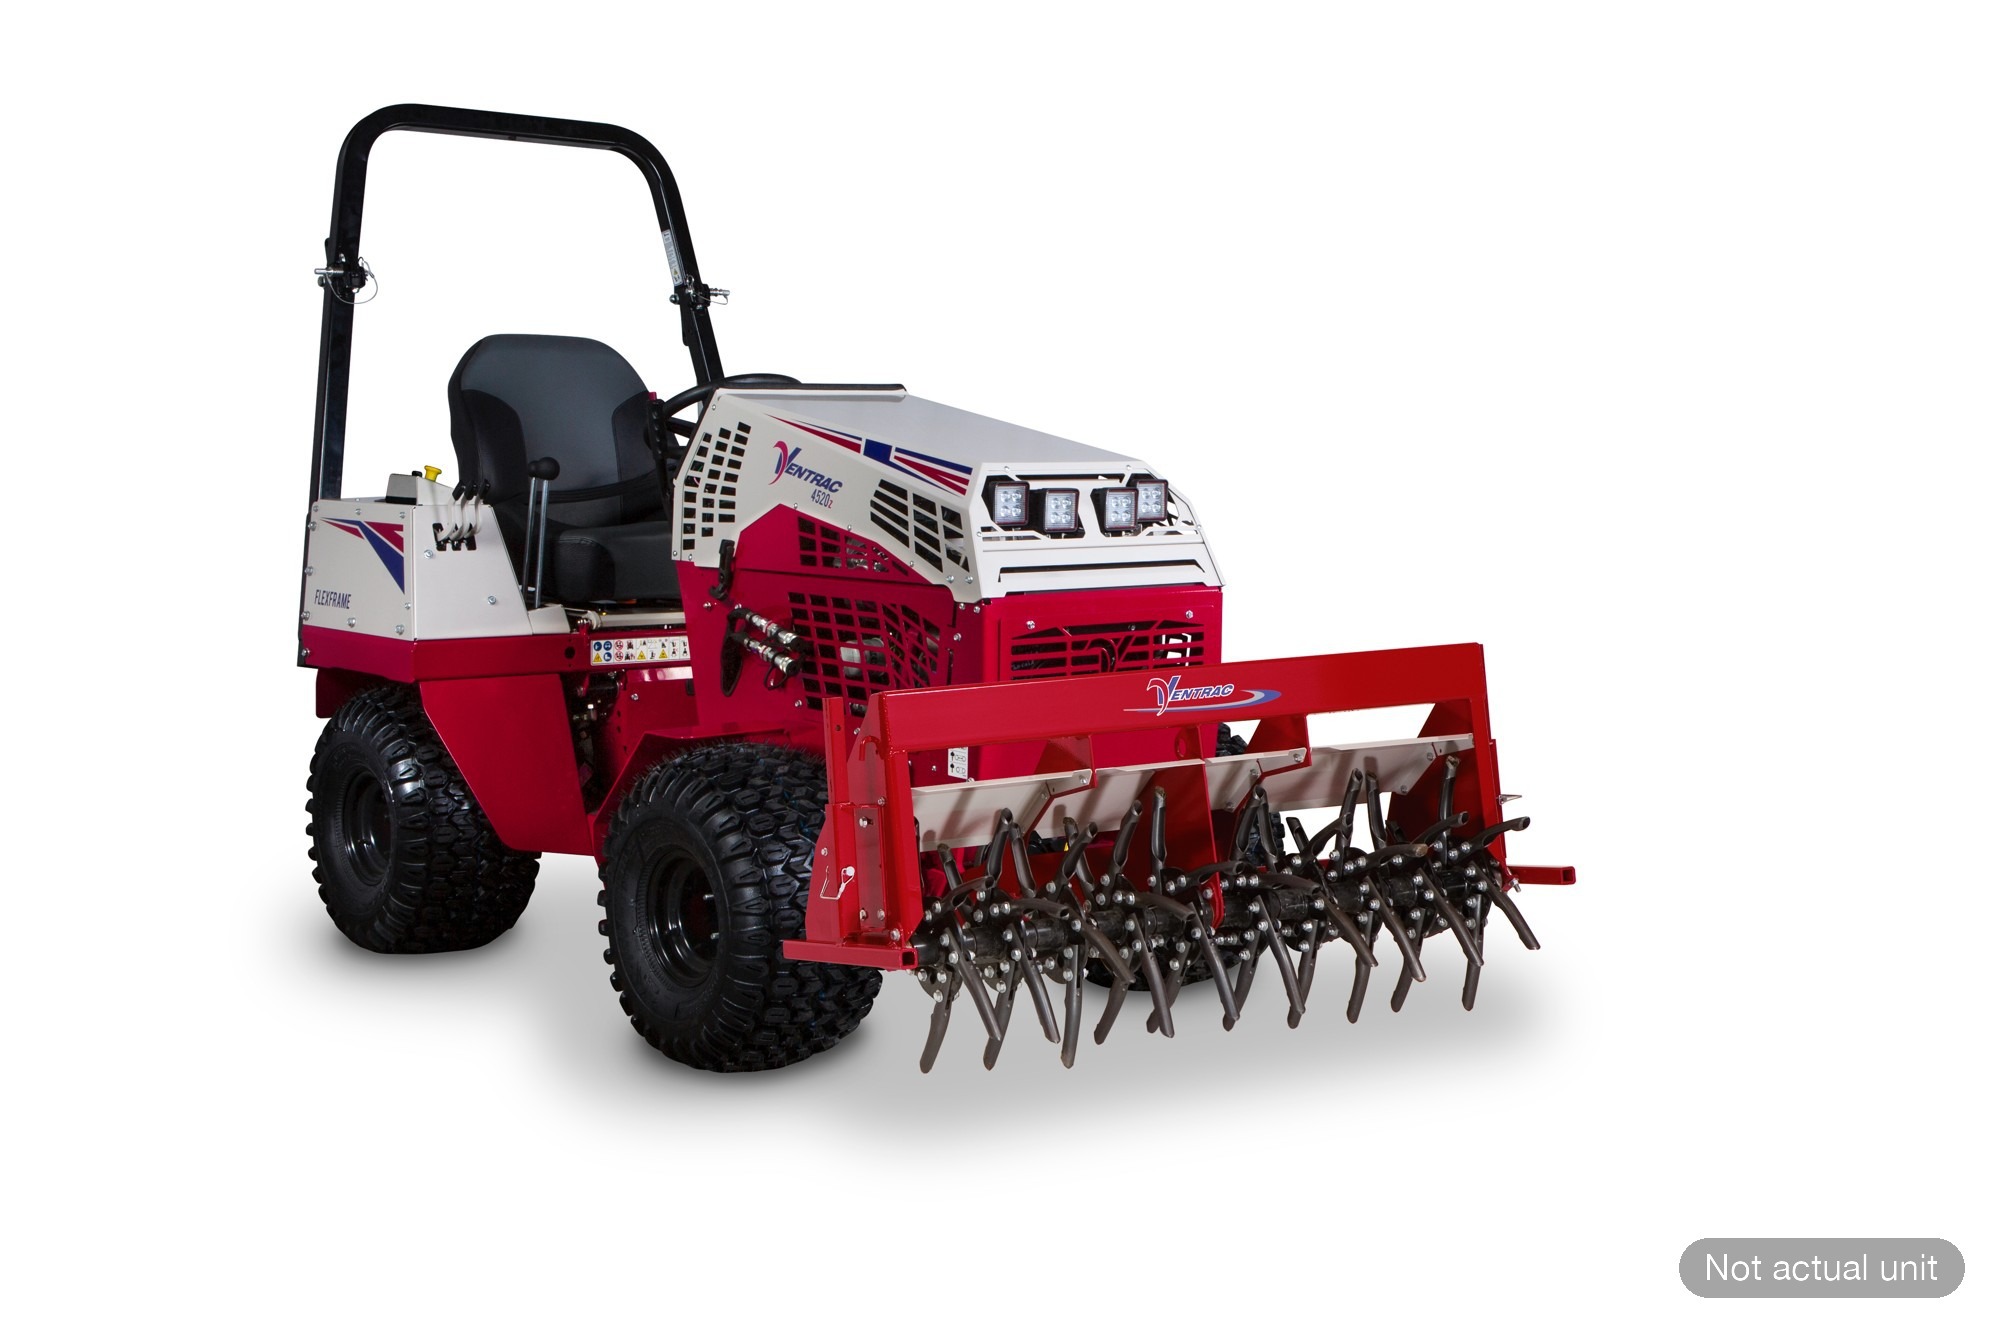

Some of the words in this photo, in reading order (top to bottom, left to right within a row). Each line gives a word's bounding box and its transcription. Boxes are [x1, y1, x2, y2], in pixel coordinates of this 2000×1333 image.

[768, 440, 843, 493] VENTRAC
[314, 589, 351, 609] FLEXFRAME
[1146, 675, 1234, 716] VENTRAC
